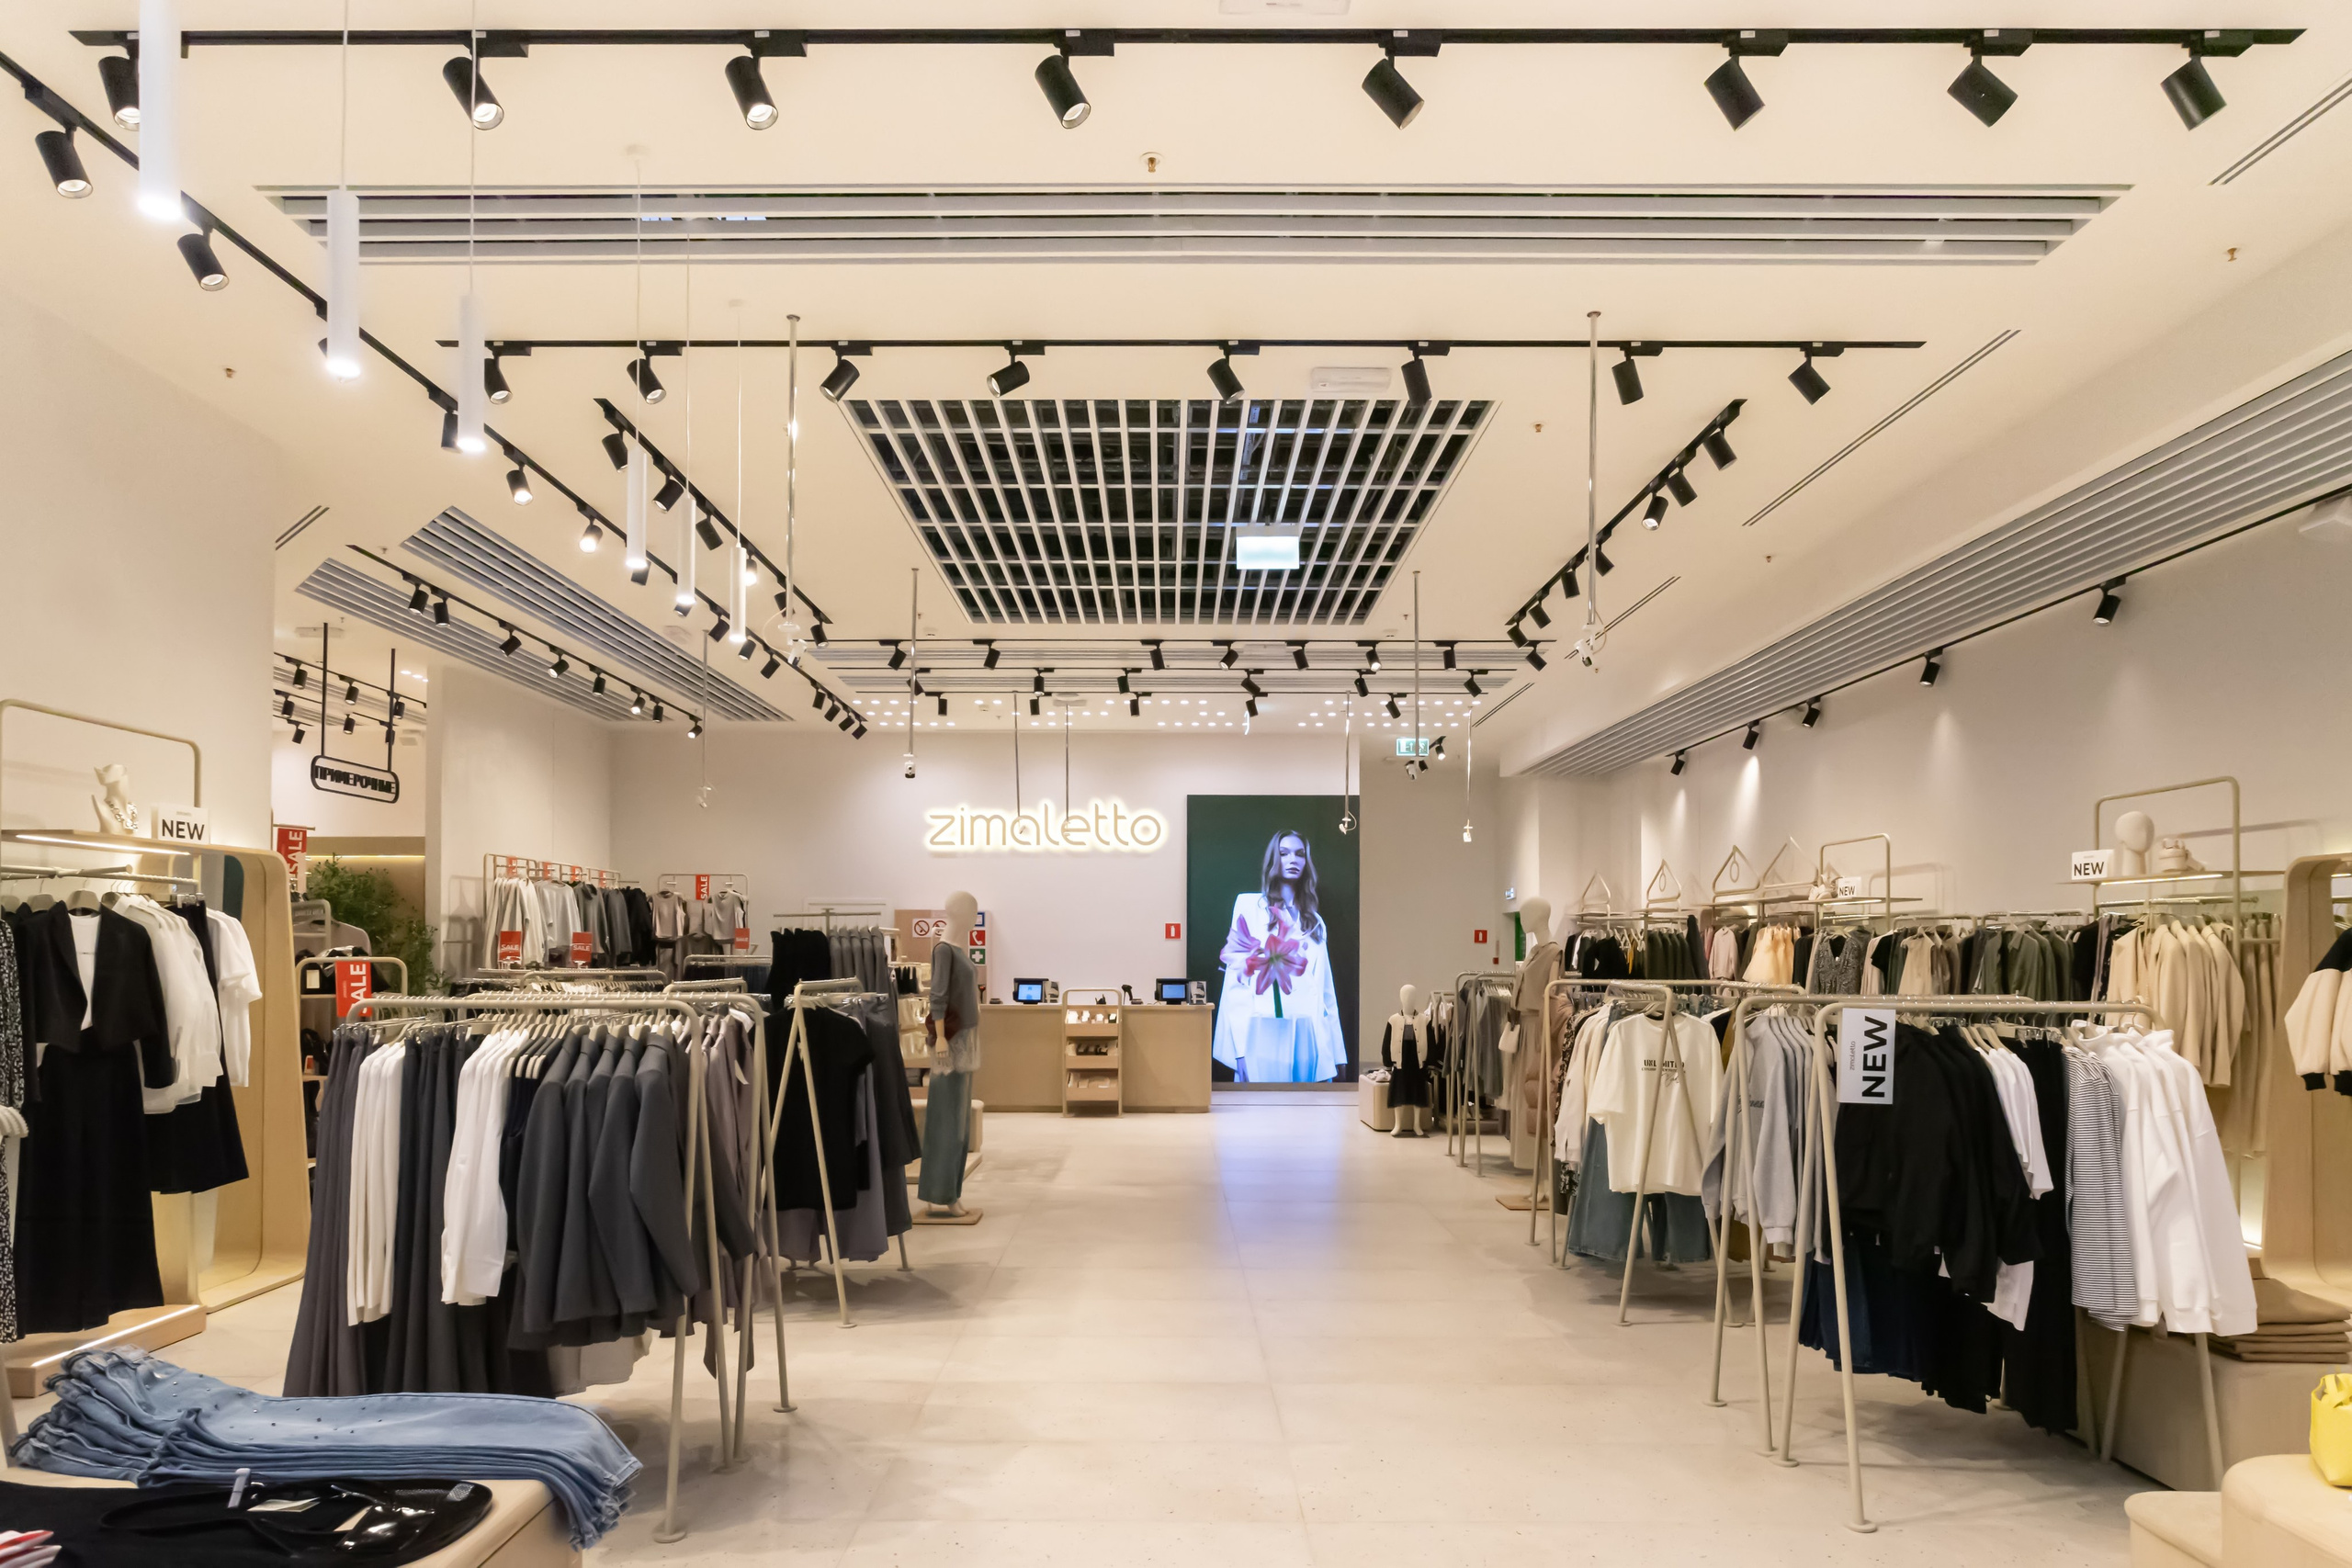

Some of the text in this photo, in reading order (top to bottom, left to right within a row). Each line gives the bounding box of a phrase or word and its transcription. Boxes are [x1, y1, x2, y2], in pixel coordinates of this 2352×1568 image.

[315, 765, 396, 795] ПРИМЕРОЧНЫЕ
[162, 818, 205, 840] NEW
[929, 803, 1161, 846] zimaletto
[2074, 862, 2105, 876] NEW
[700, 875, 708, 900] SALE
[1838, 886, 1856, 896] NEW
[1861, 1015, 1888, 1098] NEW
